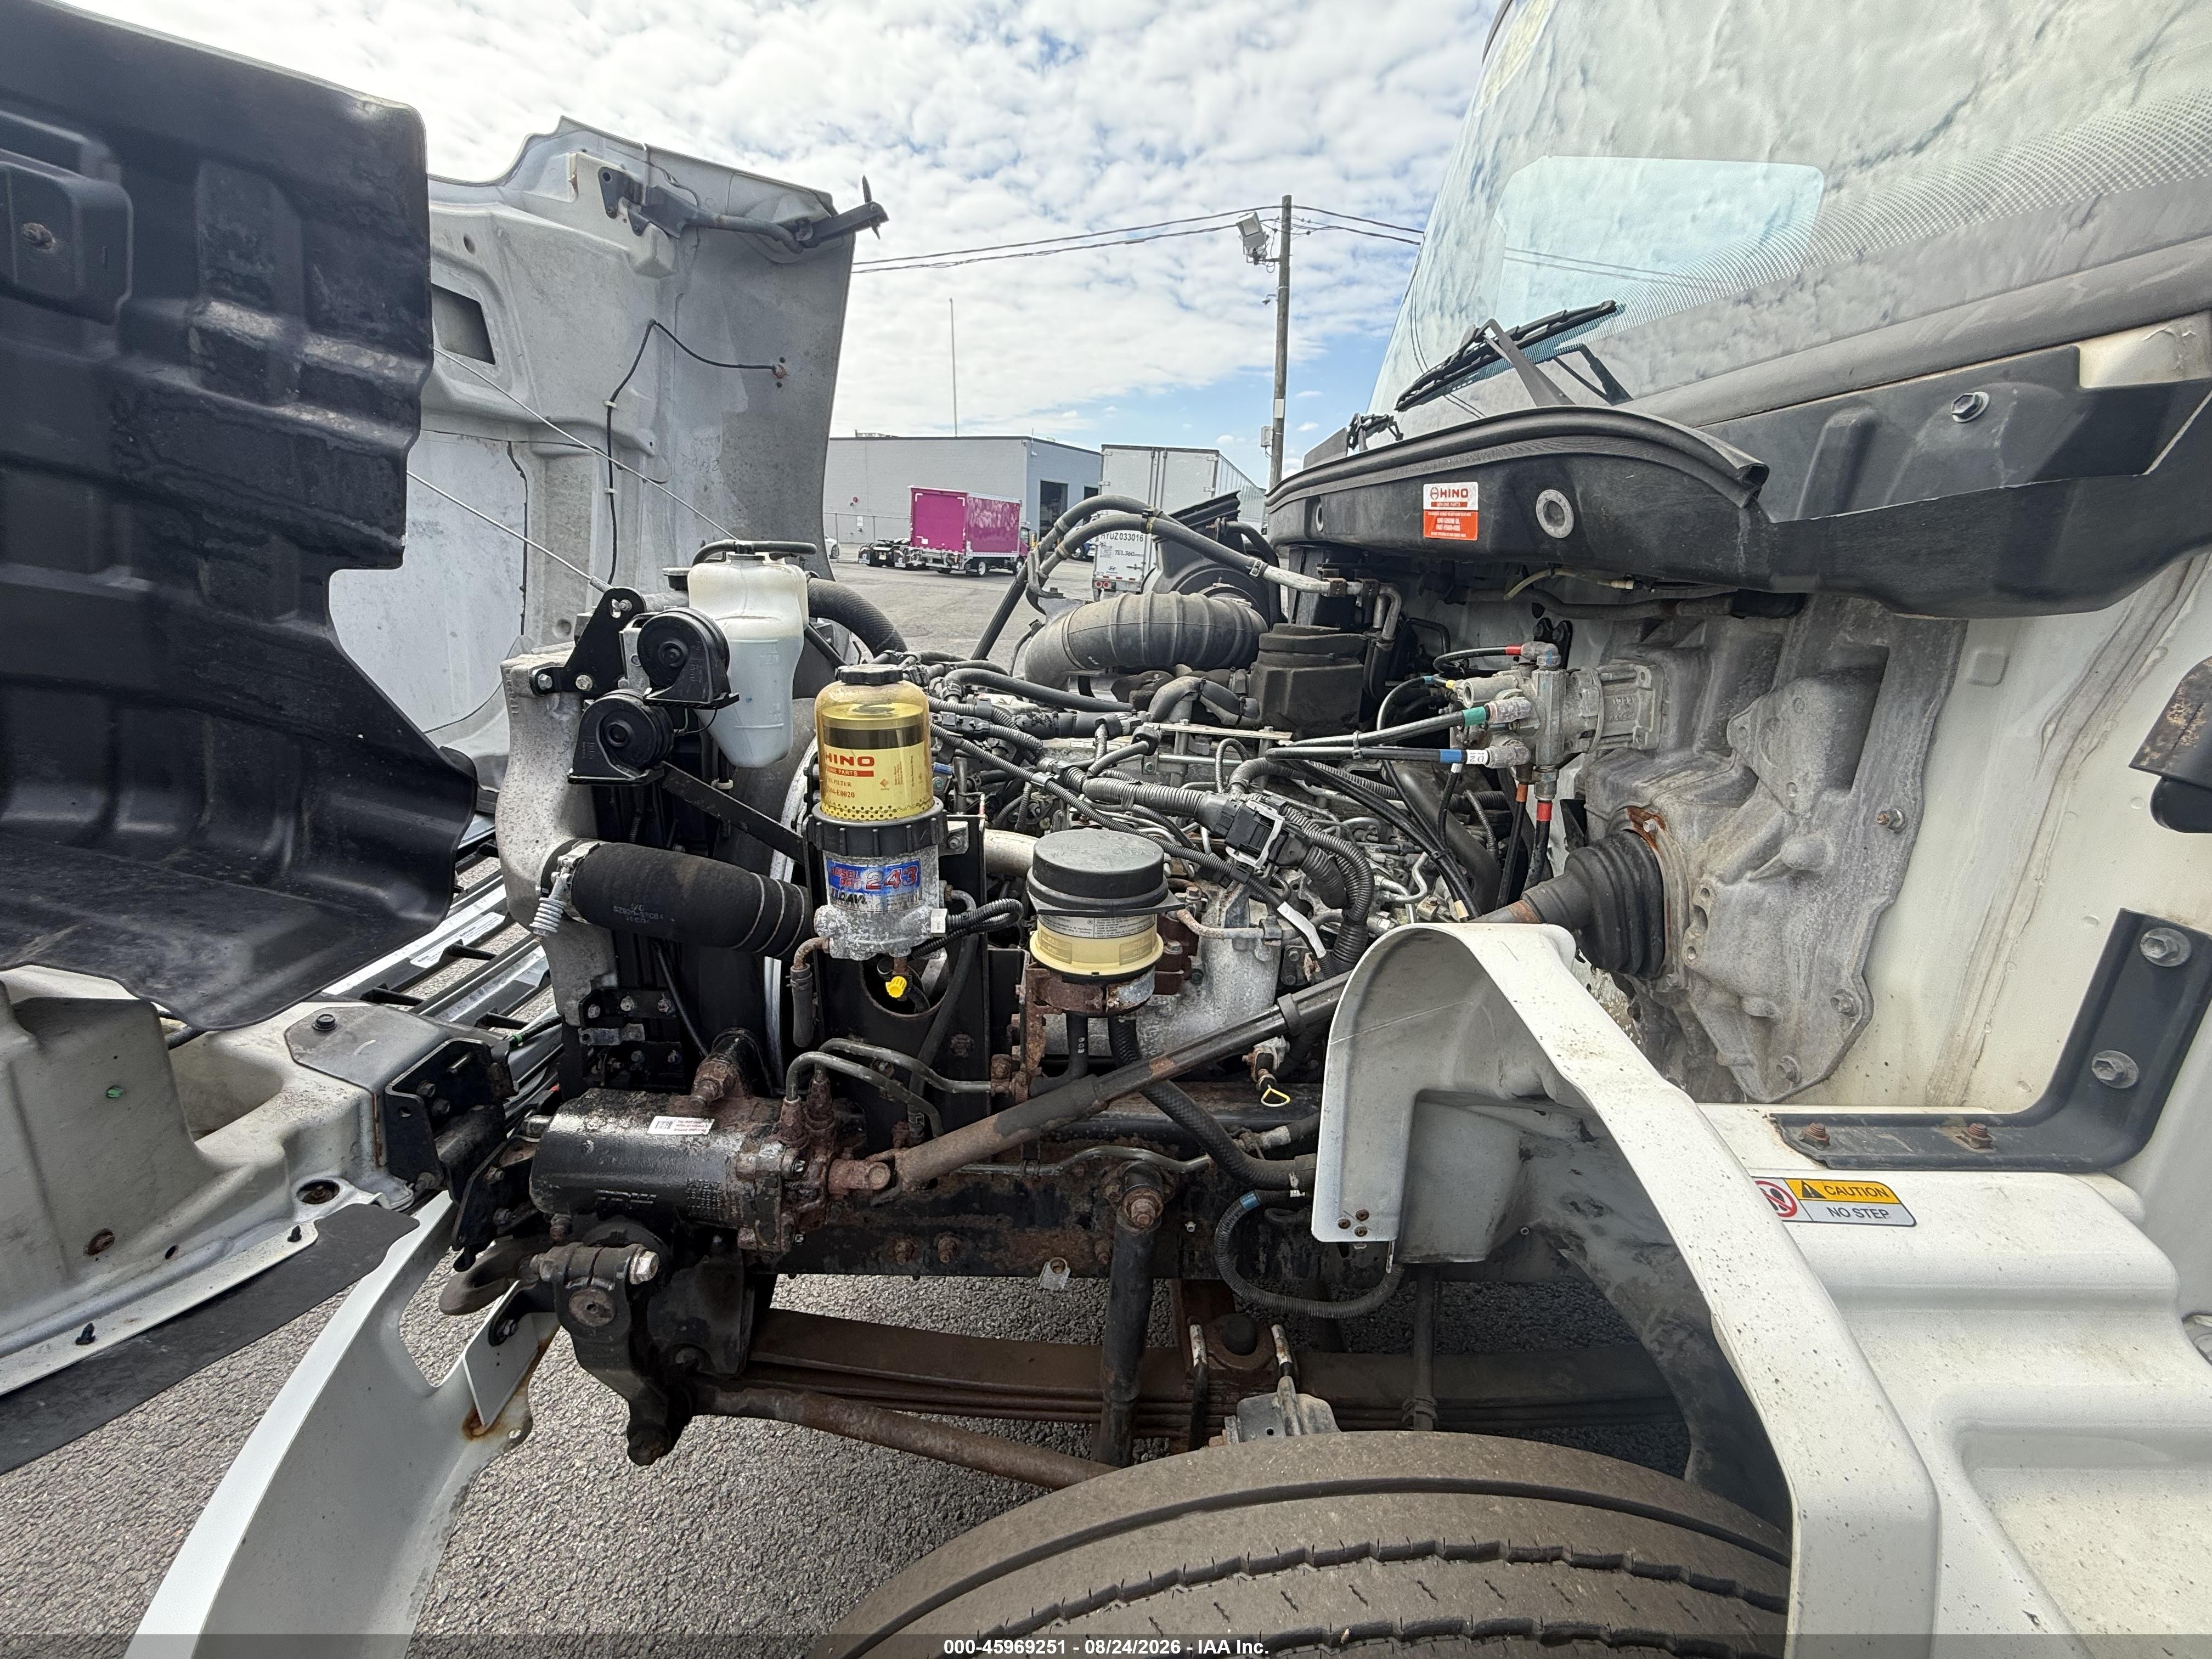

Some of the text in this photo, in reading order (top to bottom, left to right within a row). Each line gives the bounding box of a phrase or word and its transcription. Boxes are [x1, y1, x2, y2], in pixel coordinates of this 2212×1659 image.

[1440, 488, 1469, 498] HINO
[825, 752, 874, 767] HINO
[865, 865, 918, 891] 243
[1824, 1185, 1890, 1198] CAUTION
[1826, 1206, 1889, 1219] NO STEP
